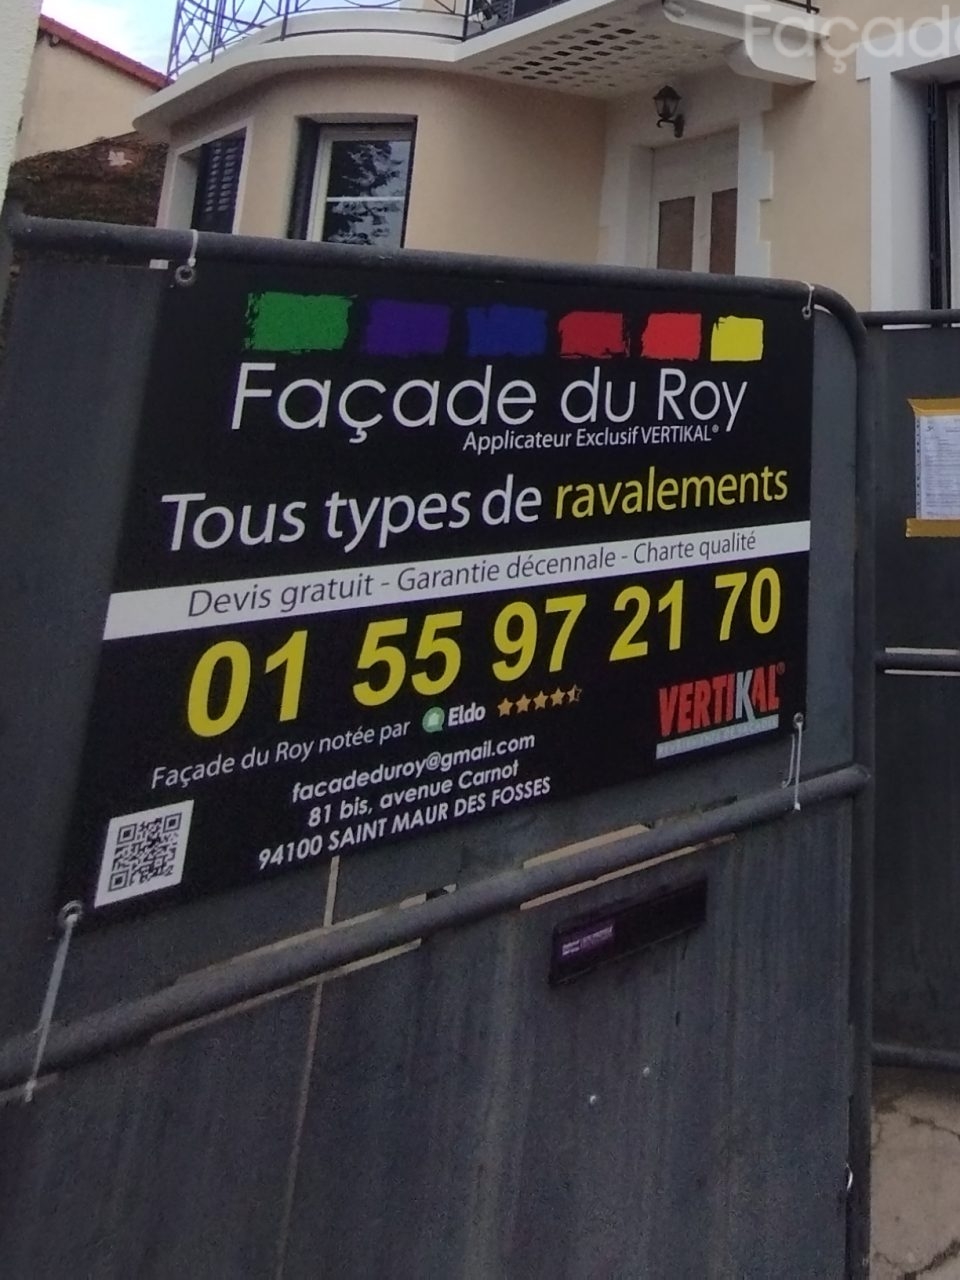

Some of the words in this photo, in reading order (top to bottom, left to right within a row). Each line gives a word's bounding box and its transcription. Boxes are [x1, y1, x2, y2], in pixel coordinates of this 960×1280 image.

[232, 361, 536, 443] Façade
[560, 366, 635, 424] du
[658, 368, 748, 432] Roy
[463, 429, 571, 455] Applicateur
[576, 426, 638, 447] Exclusif
[161, 491, 306, 551] Tous
[324, 491, 471, 554] types
[483, 474, 542, 526] de
[556, 464, 789, 519] ravalements
[188, 586, 271, 618] Devis
[280, 573, 373, 612] gratuit
[398, 560, 499, 593] Garantie
[507, 546, 615, 578] décennale
[633, 541, 694, 565] Charte
[699, 531, 757, 559] qualité
[187, 630, 308, 737] 01
[352, 610, 463, 706] 55
[491, 594, 587, 681] 97
[609, 579, 685, 662] 21
[715, 567, 782, 642] 70
[151, 753, 235, 789] Façade
[241, 747, 269, 769] du
[275, 741, 313, 764] Roy
[319, 726, 374, 753] notée
[379, 719, 411, 744] par
[448, 702, 485, 727] Eldo
[292, 734, 535, 803] facadeduroy@gmail.com
[259, 834, 323, 870] 94100
[327, 818, 387, 851] SAINT
[391, 802, 449, 834] MAUR
[454, 791, 486, 817] DES
[491, 776, 551, 807] FOSSES
[307, 804, 331, 827] 81
[339, 796, 373, 820] bis,
[380, 778, 453, 810] avenue
[458, 759, 519, 790] Carnot
